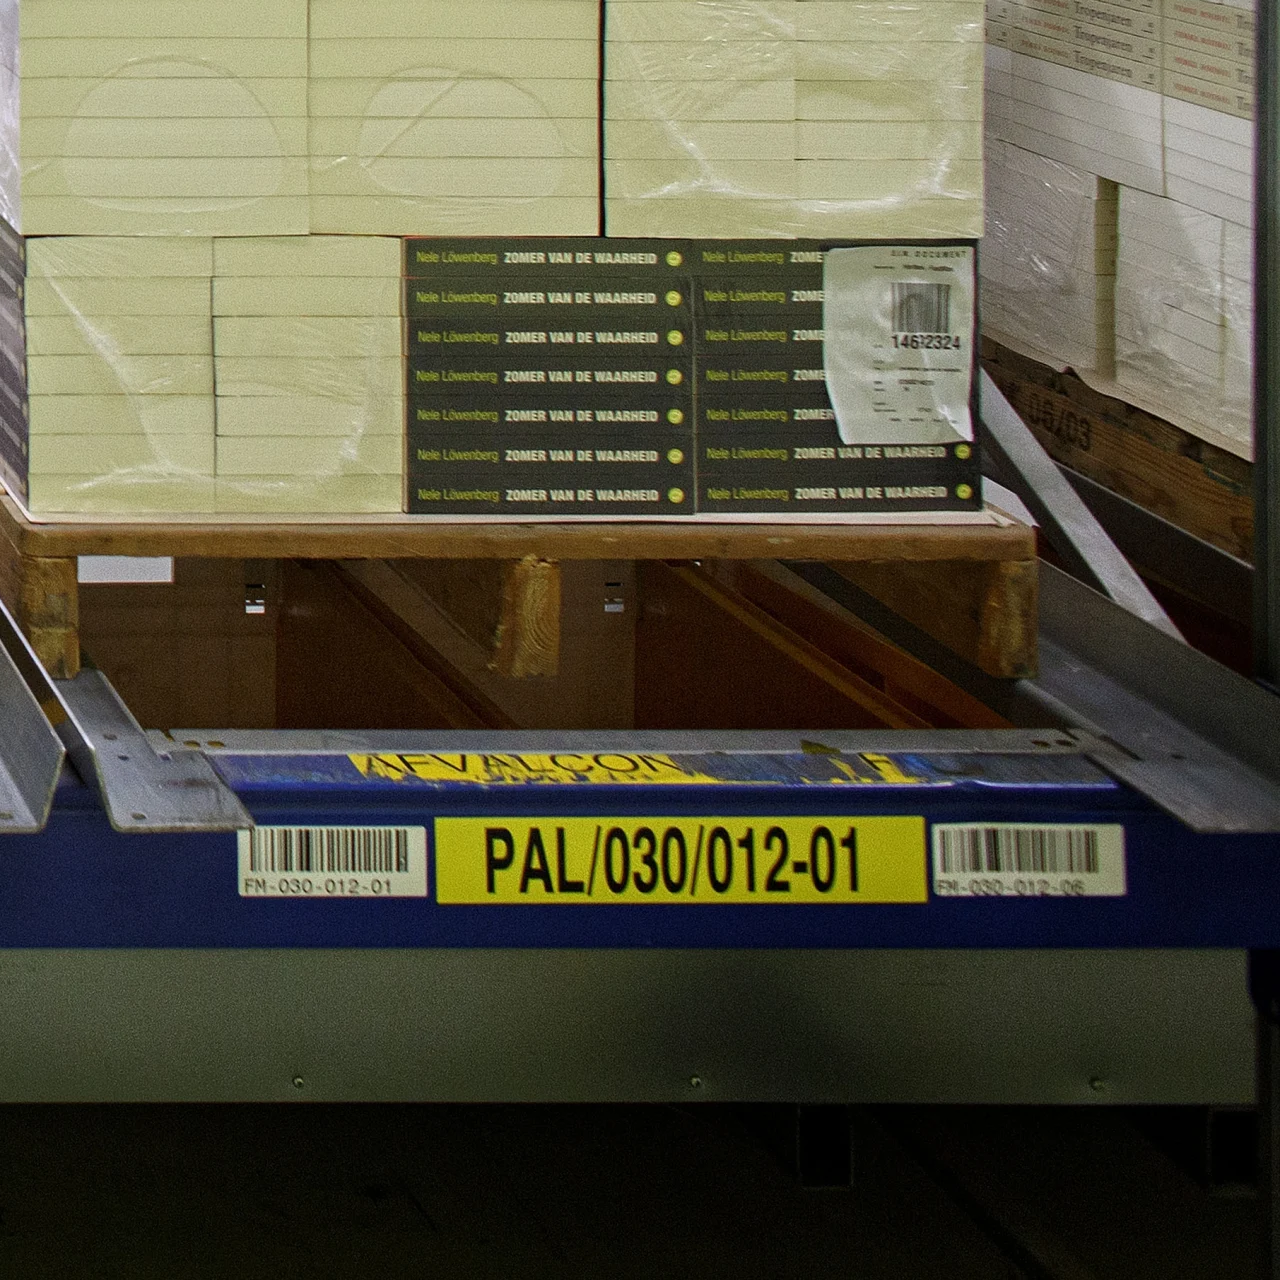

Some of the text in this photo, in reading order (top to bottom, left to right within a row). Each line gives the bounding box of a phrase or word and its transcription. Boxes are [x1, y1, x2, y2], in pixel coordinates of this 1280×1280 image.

[505, 253, 545, 263] ZOMER
[549, 253, 572, 263] VAN
[576, 253, 592, 263] DE
[595, 253, 657, 263] WAARHEID
[504, 293, 545, 303] ZOMER
[548, 293, 572, 303] VAN
[576, 293, 591, 303] DE
[594, 293, 656, 303] WAARHEID
[506, 332, 547, 342] ZOMER
[550, 332, 574, 342] VAN
[577, 332, 593, 342] DE
[596, 332, 658, 343] WAARHEID
[505, 371, 545, 381] ZOMER
[549, 371, 572, 381] VAN
[576, 371, 591, 382] DE
[595, 371, 656, 382] WAARHEID
[505, 410, 546, 421] ZOMER
[550, 411, 573, 421] VAN
[577, 411, 592, 421] DE
[596, 411, 657, 421] WAARHEID
[506, 450, 546, 461] ZOMER
[550, 450, 573, 461] VAN
[577, 450, 593, 461] DE
[596, 451, 658, 461] WAARHEID
[506, 490, 547, 500] ZOMER
[550, 490, 574, 500] VAN
[578, 490, 593, 501] DE
[597, 490, 658, 500] WAARHEID
[485, 824, 858, 895] PAL/030/012-01
[243, 878, 392, 895] FM-030-012-01
